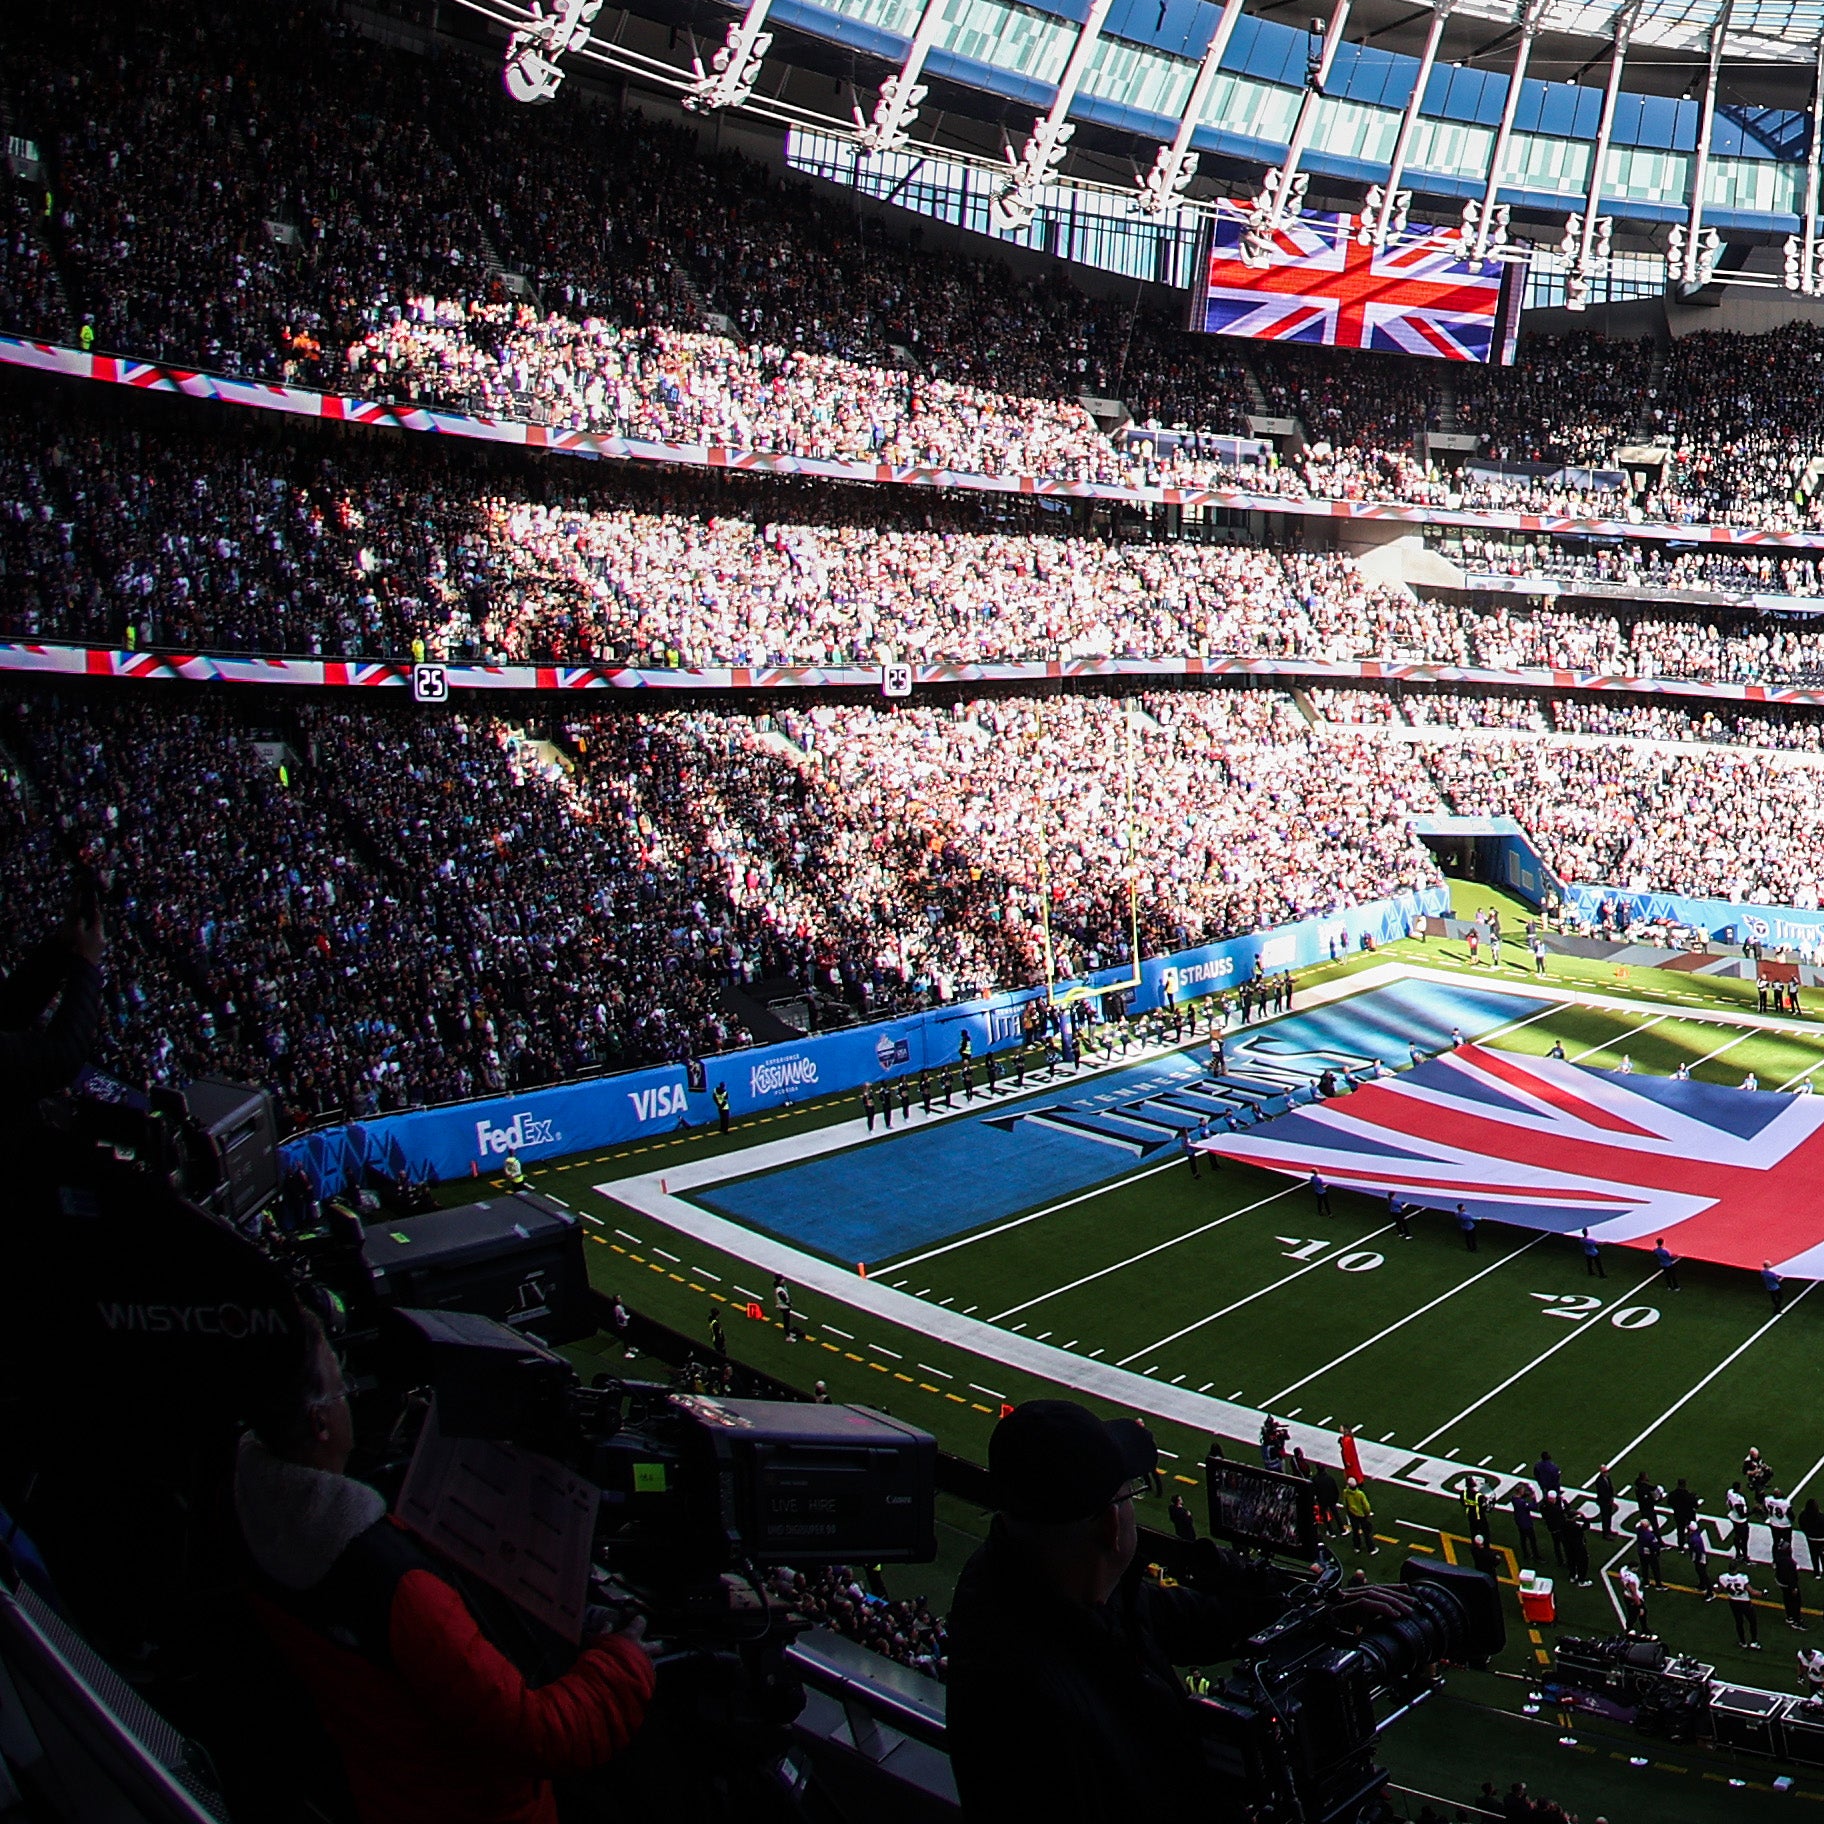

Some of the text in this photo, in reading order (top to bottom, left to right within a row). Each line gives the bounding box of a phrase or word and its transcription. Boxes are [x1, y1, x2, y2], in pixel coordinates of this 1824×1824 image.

[422, 675, 440, 692] 25
[896, 675, 905, 687] 25
[1179, 956, 1234, 987] STRAUSS
[627, 1082, 689, 1122] VISA
[475, 1111, 554, 1156] FedEx
[1540, 1294, 1661, 1330] 20
